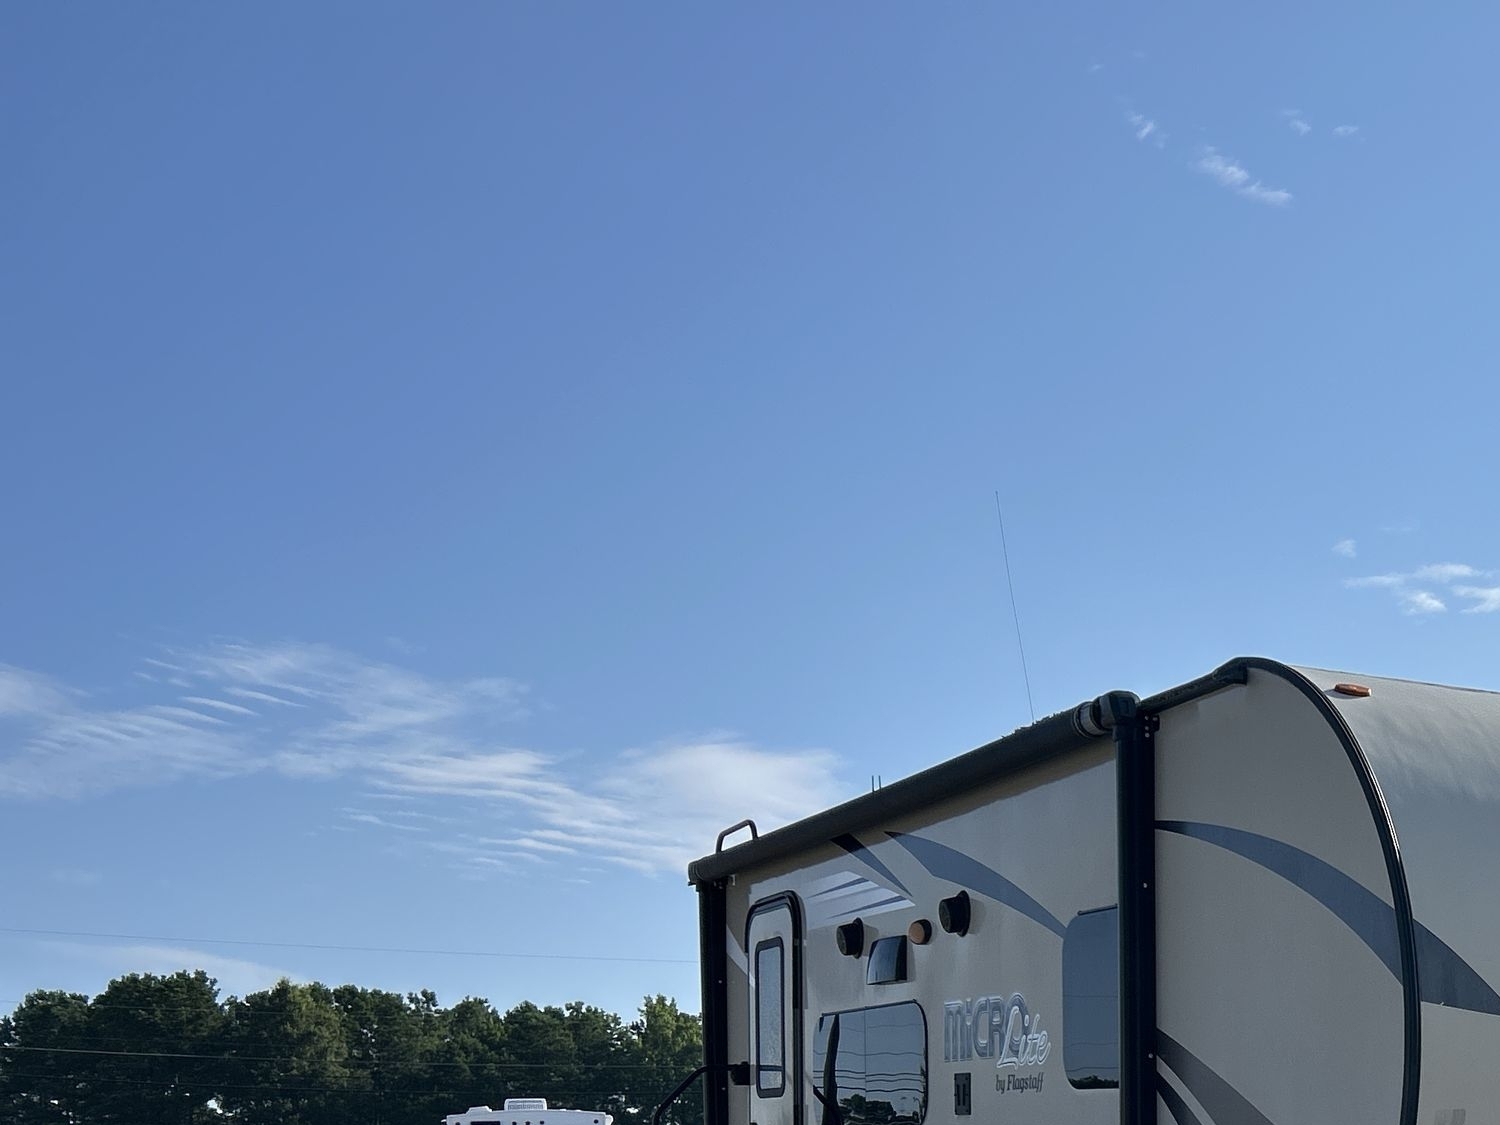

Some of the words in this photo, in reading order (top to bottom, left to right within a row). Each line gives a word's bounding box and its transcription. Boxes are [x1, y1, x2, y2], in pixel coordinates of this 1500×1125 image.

[996, 1006, 1051, 1070] Lite
[995, 1074, 1006, 1094] by
[1006, 1072, 1045, 1094] Flagstaff
